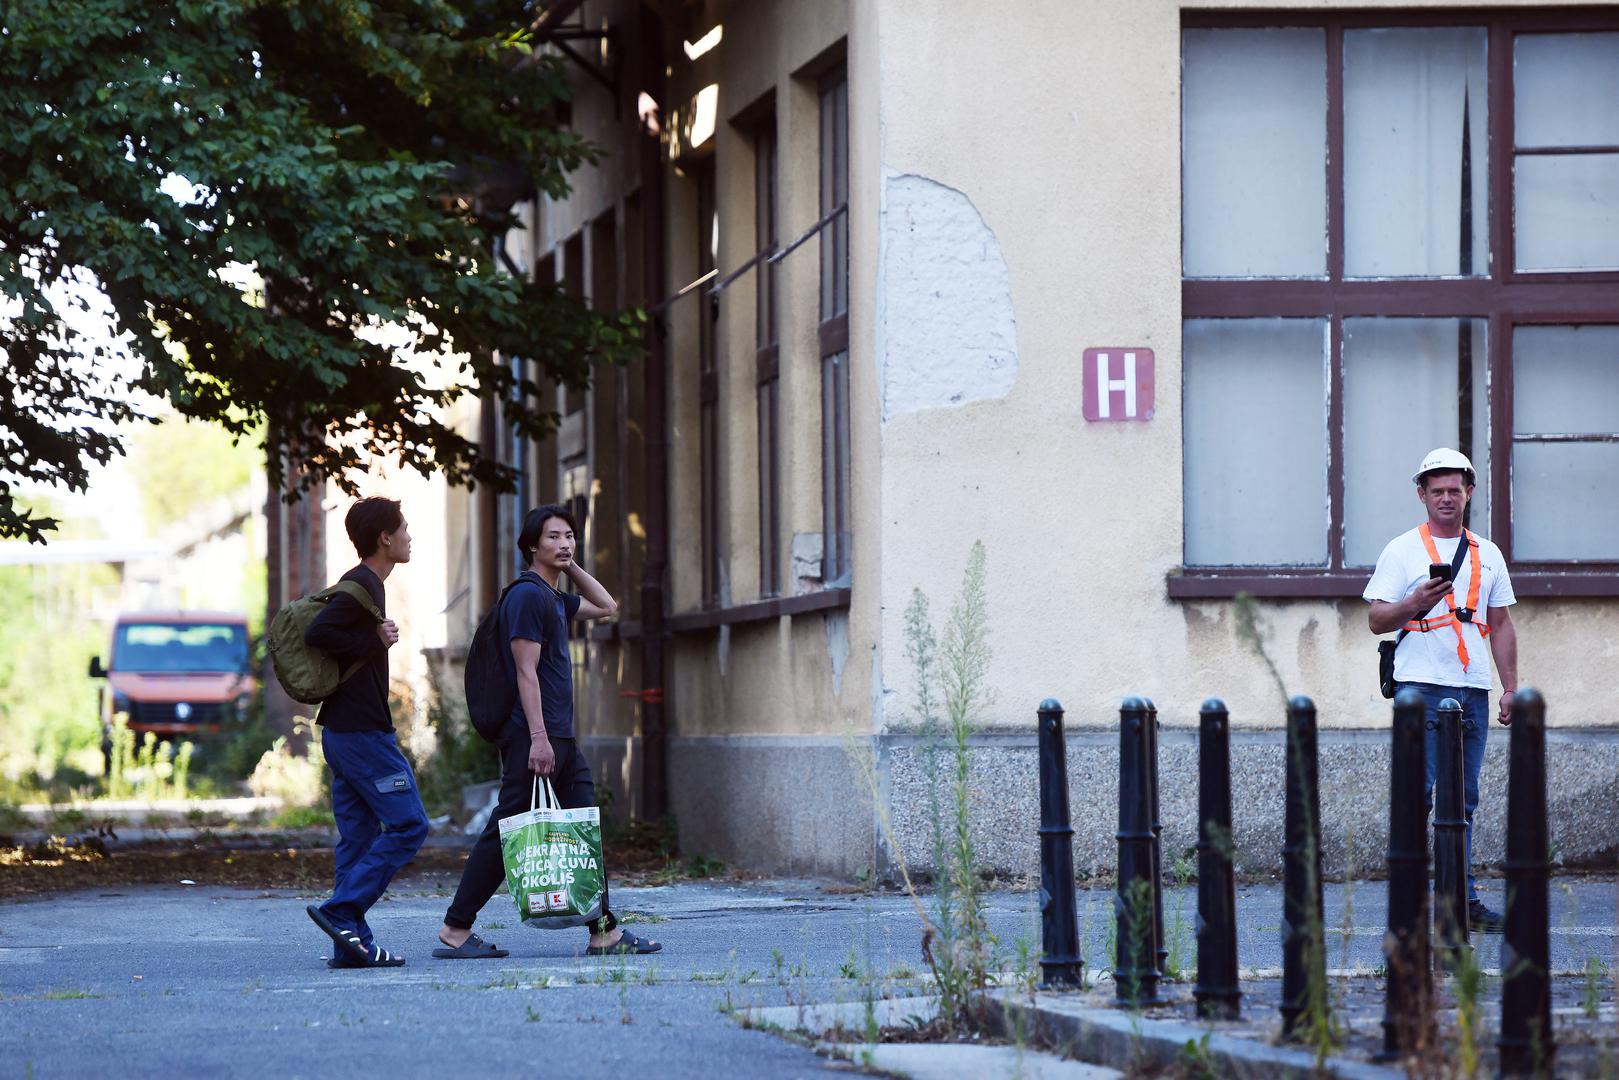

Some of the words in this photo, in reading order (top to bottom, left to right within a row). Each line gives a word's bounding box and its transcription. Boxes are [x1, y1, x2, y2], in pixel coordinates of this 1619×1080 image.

[1097, 352, 1137, 418] H
[515, 842, 591, 864] VEKRATNA
[557, 854, 598, 870] ČUVA
[521, 868, 575, 889] OKOLIŠ
